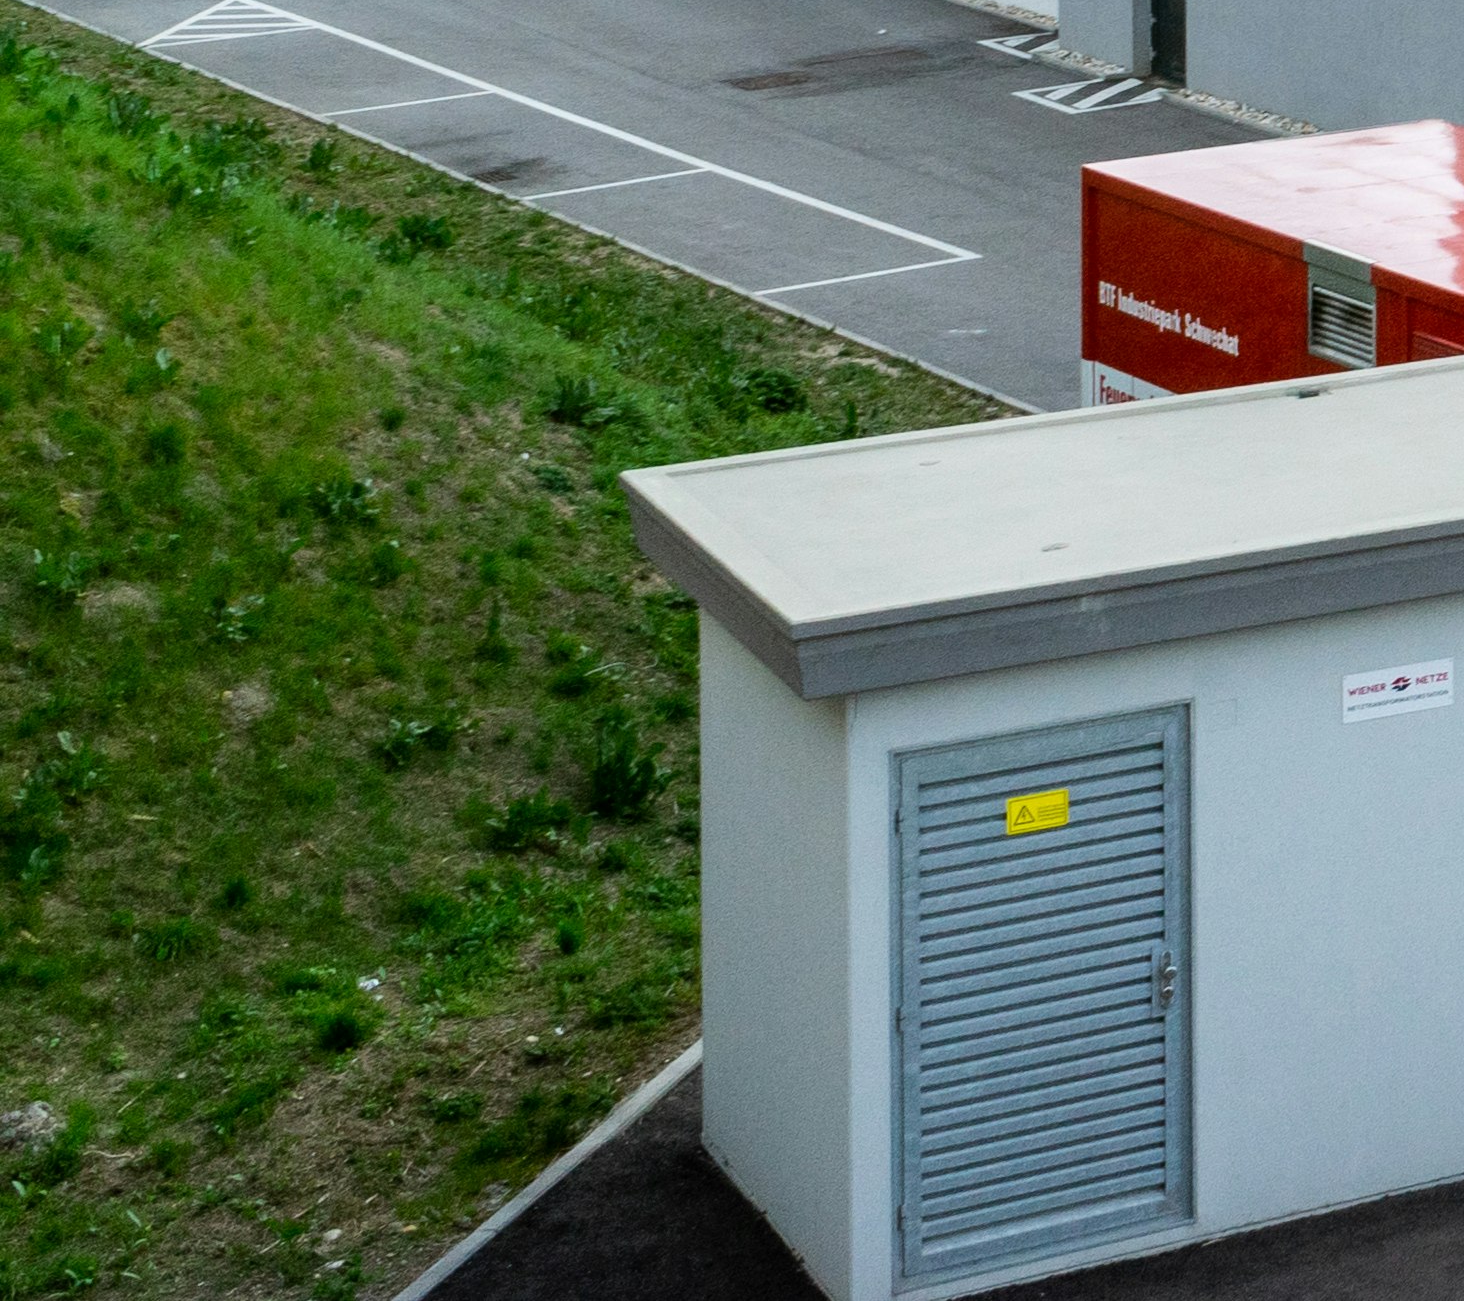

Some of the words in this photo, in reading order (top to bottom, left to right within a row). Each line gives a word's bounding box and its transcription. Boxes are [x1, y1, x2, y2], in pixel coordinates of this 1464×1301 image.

[1118, 287, 1182, 333] Industriepark
[1185, 312, 1240, 358] Schwechat
[1347, 682, 1388, 696] WIENER
[1415, 671, 1449, 685] NETZE
